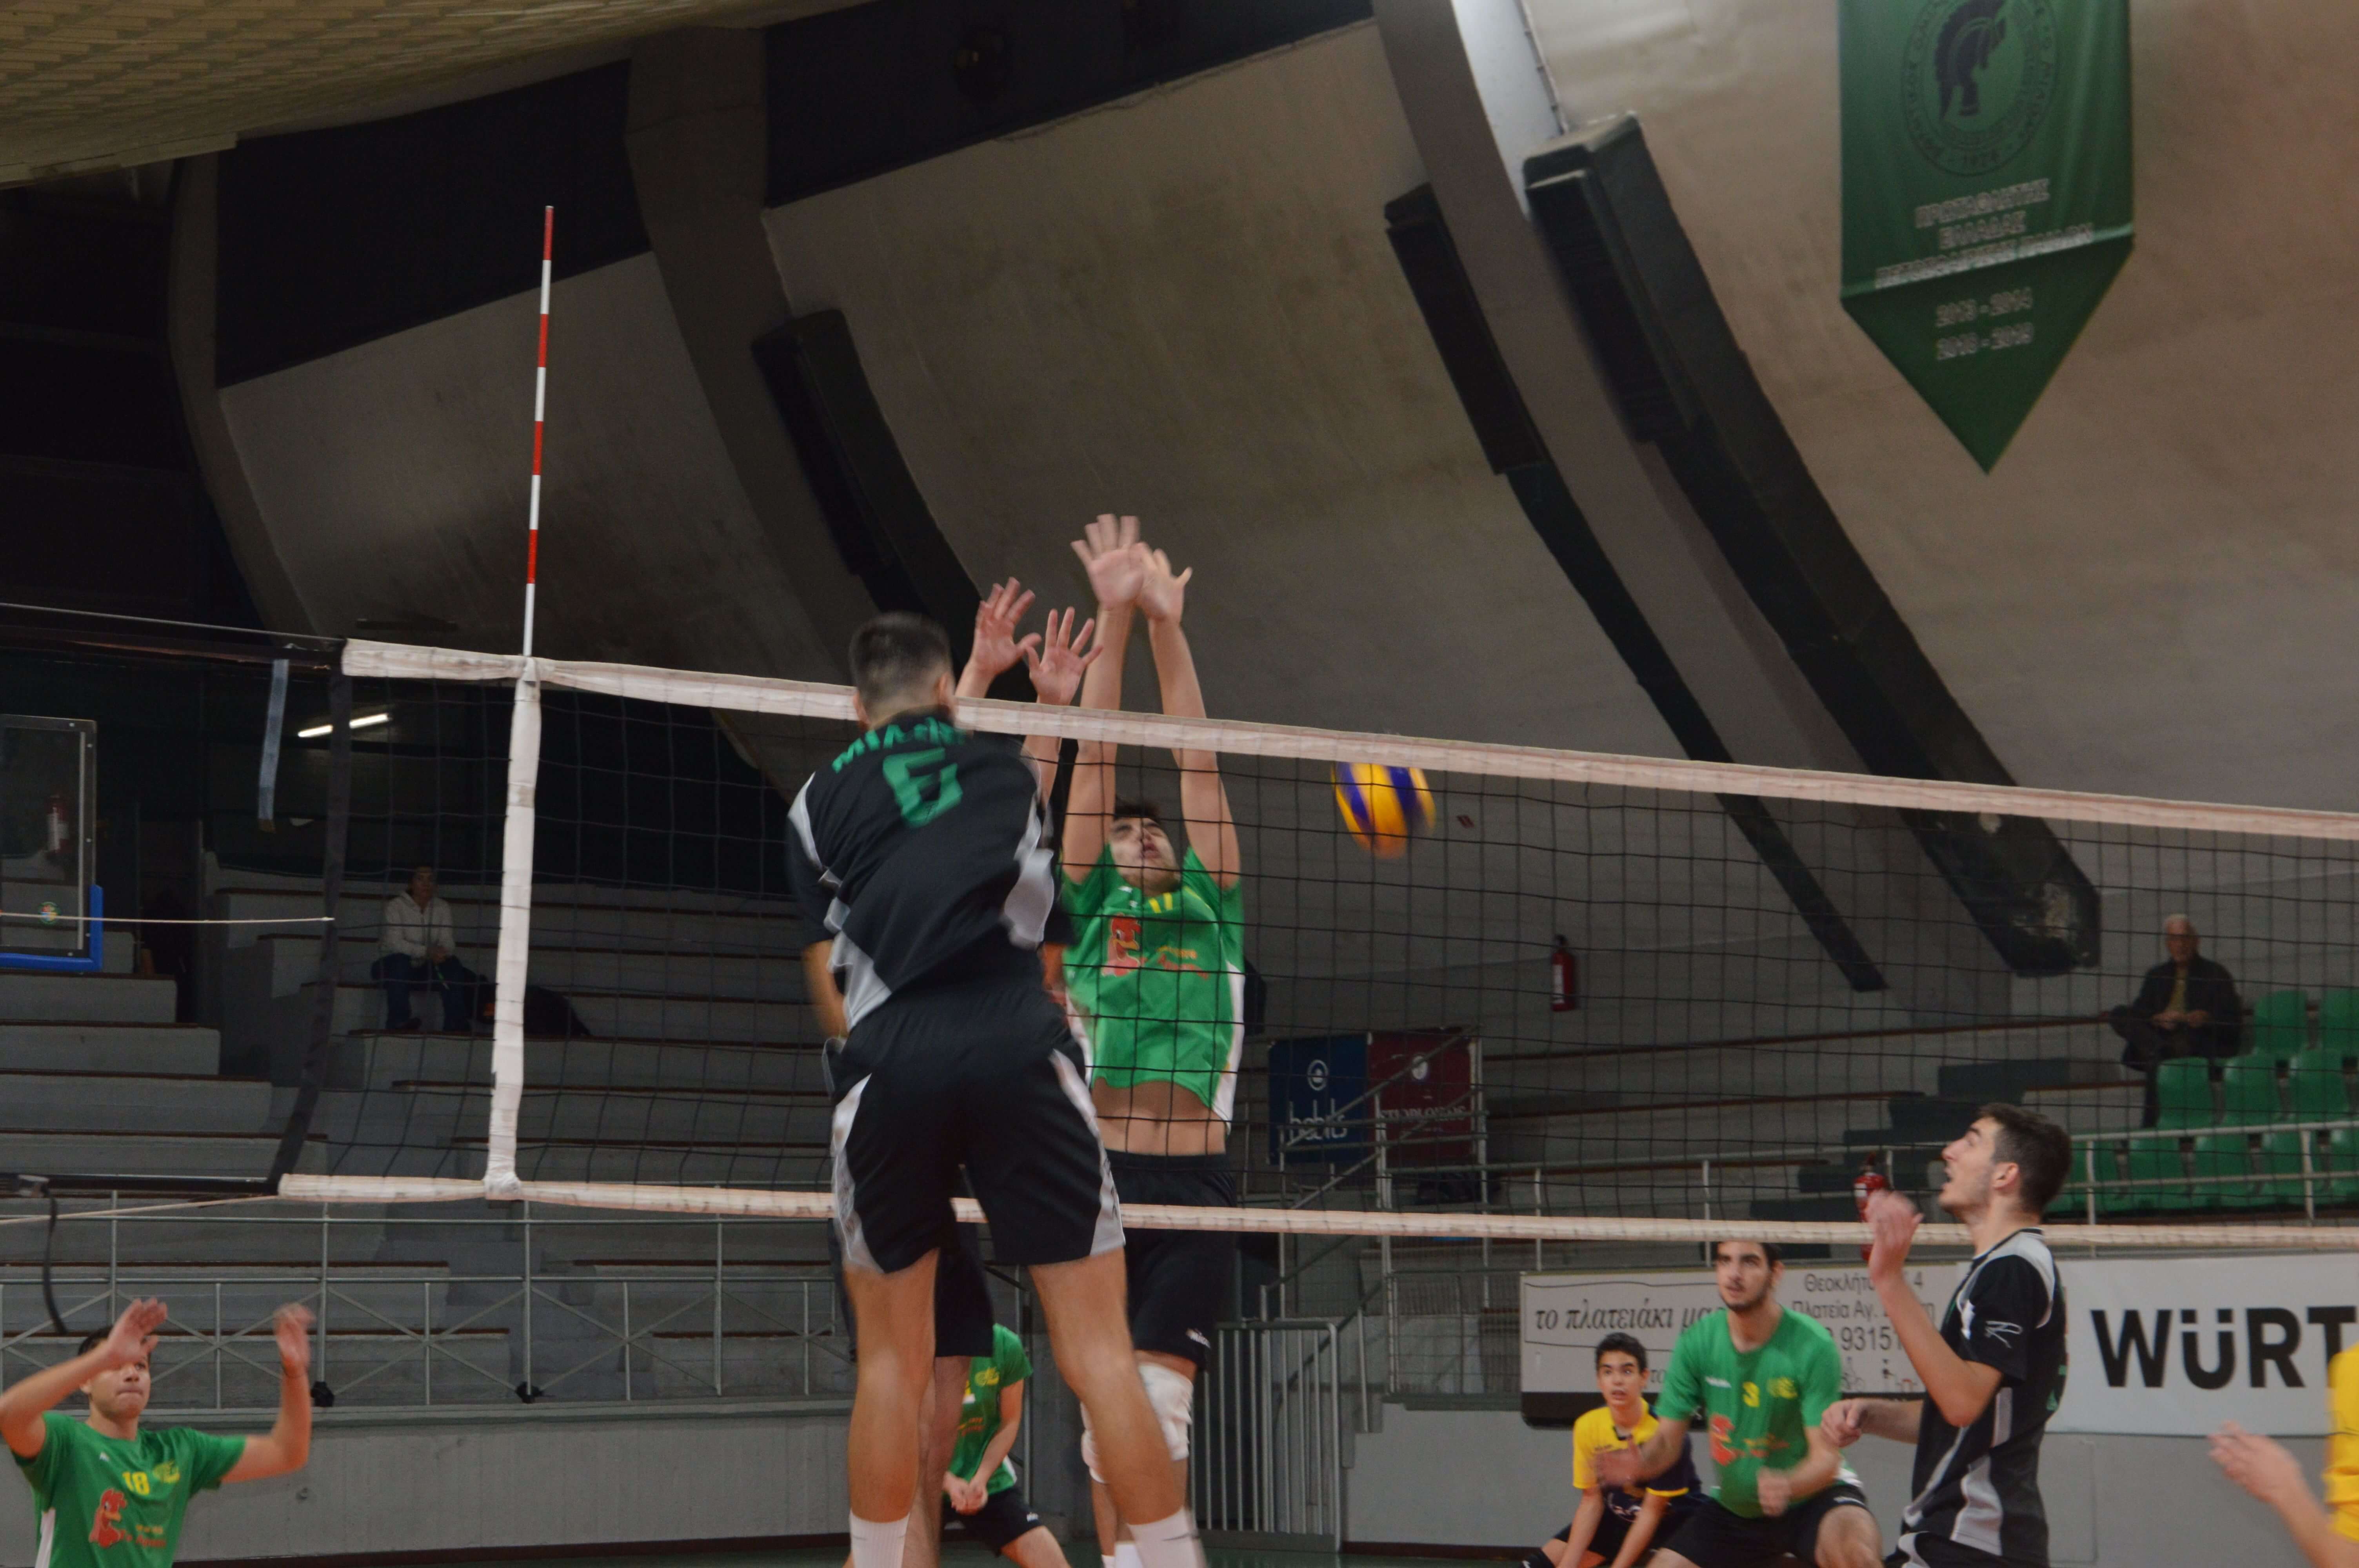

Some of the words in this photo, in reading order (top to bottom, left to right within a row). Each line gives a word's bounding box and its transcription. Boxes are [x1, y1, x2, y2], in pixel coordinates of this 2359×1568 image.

[1536, 1310, 1558, 1329] το
[1566, 1298, 1674, 1329] πλατειάκι
[1681, 1307, 1726, 1335] μα
[1792, 1300, 1849, 1318] Πλατεία
[122, 1471, 150, 1496] 18
